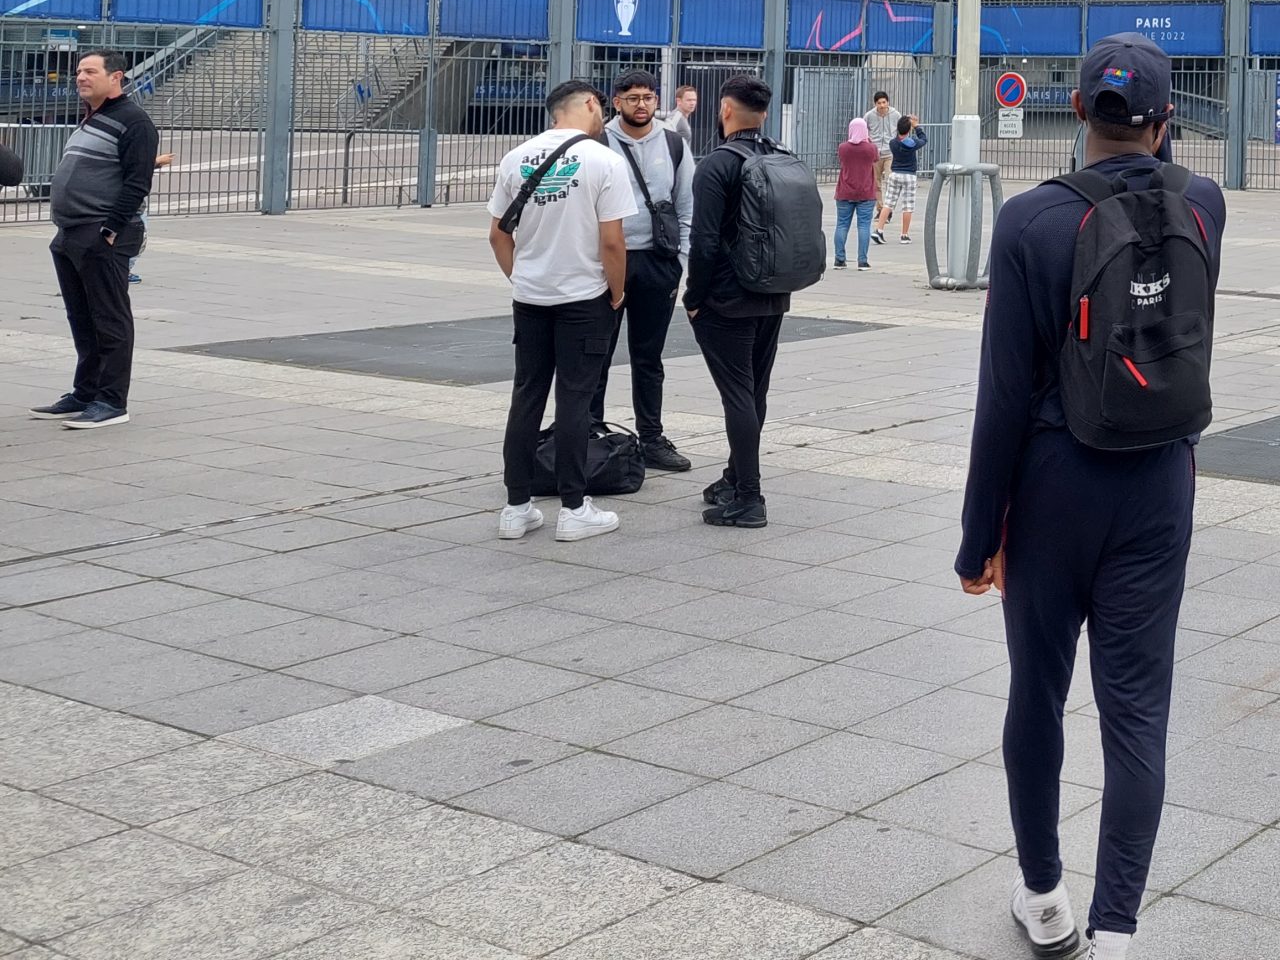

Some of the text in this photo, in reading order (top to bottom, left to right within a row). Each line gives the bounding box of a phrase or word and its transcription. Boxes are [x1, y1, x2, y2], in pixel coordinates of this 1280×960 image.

[1135, 17, 1171, 29] PARIS
[1160, 31, 1185, 41] 2022
[1025, 91, 1051, 100] ARIS
[521, 149, 579, 166] adias
[1137, 294, 1163, 306] PARIS
